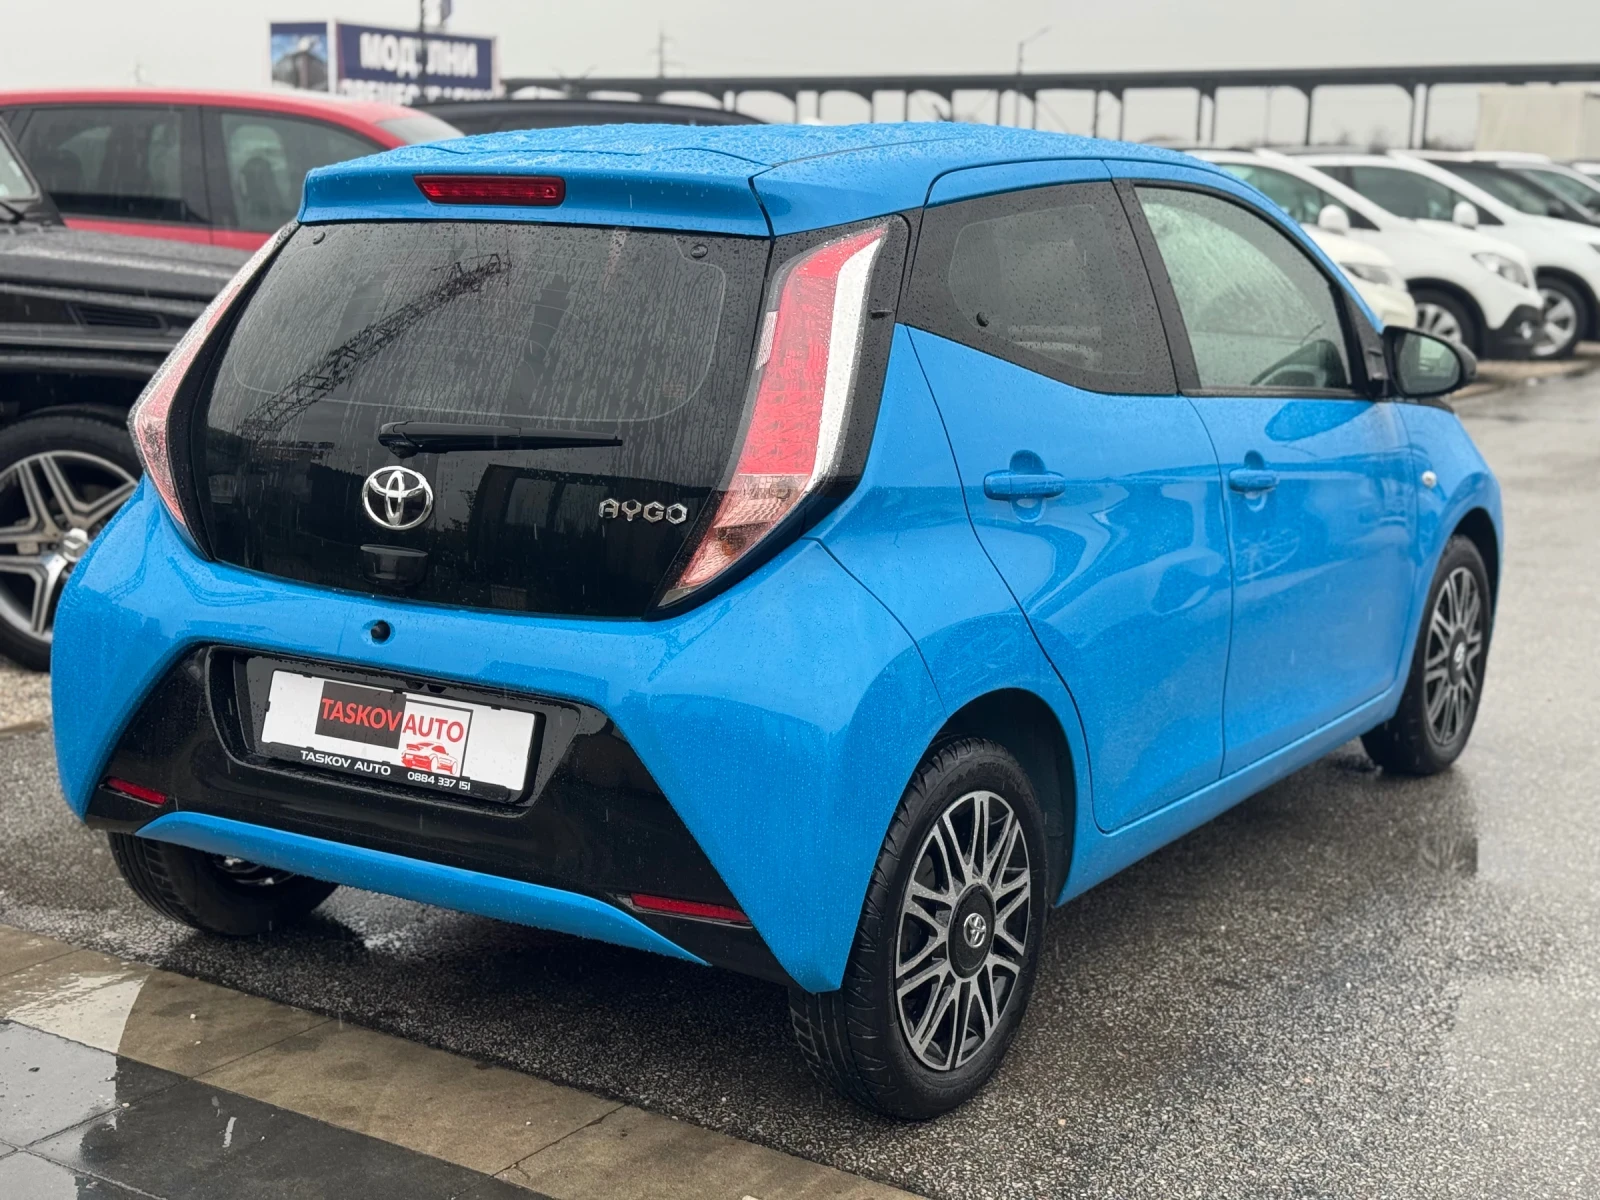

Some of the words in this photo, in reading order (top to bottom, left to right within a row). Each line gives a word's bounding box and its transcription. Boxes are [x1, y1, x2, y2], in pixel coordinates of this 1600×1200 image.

[598, 498, 688, 524] AYGO
[321, 698, 402, 731] TASKOV
[402, 714, 464, 742] AUTO
[301, 750, 351, 768] TASKOV
[354, 760, 391, 776] AUTO
[407, 771, 435, 784] 0884
[437, 776, 457, 788] 337
[458, 780, 471, 791] 151
